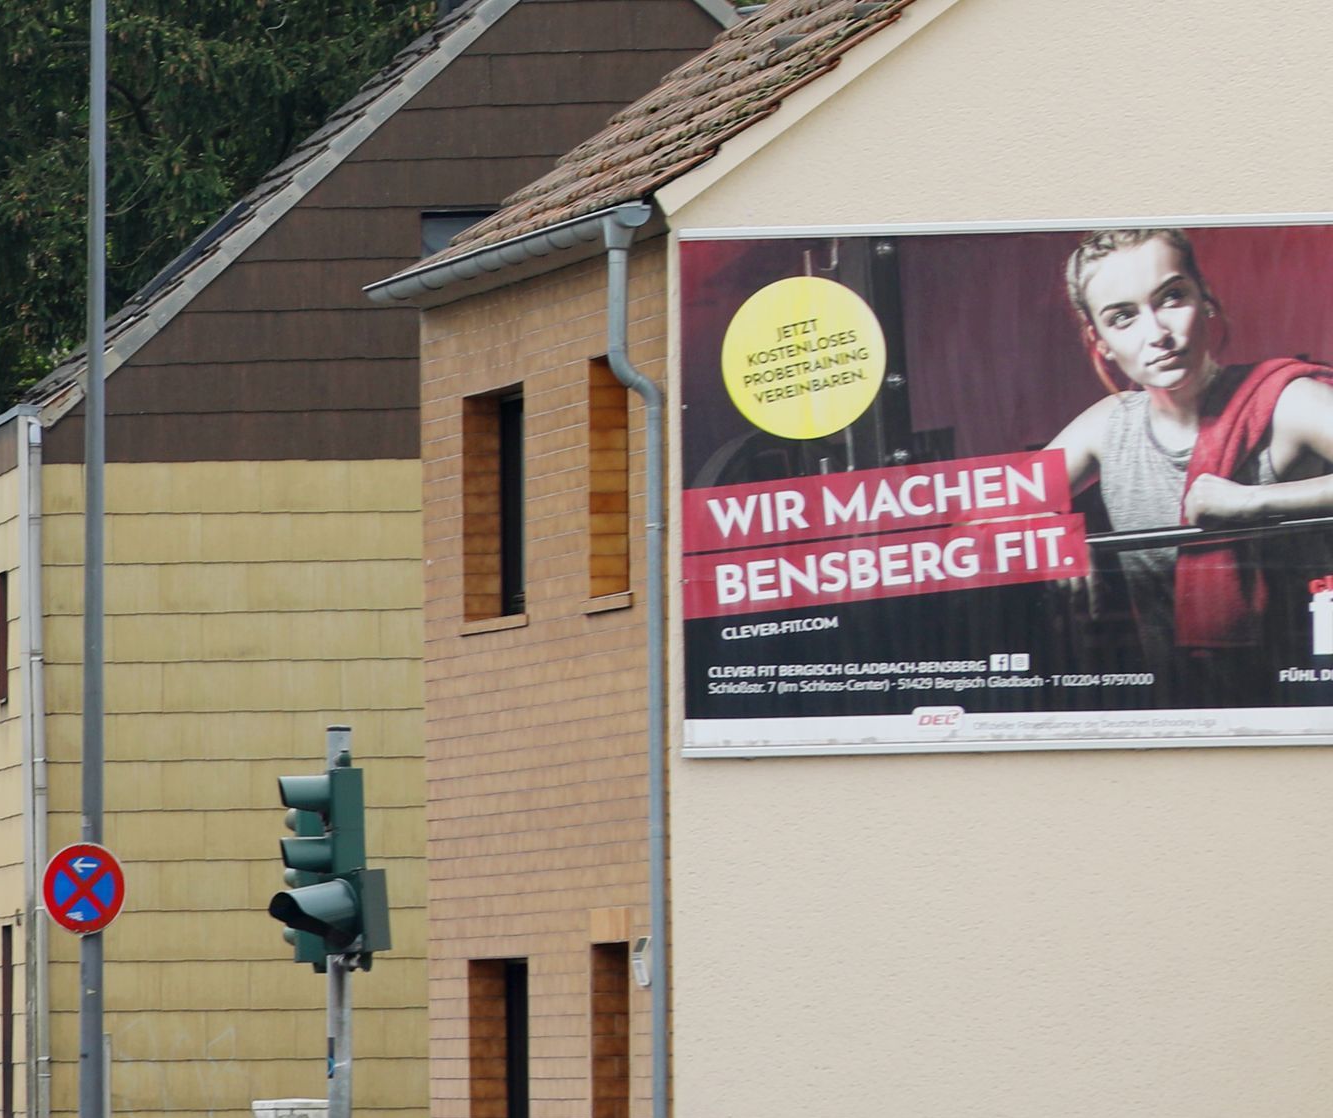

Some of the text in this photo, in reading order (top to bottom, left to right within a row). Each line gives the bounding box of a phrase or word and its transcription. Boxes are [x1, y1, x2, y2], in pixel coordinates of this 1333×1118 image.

[776, 318, 818, 342] JETZT
[746, 329, 857, 367] KOSTENLOSES
[742, 347, 870, 389] PROBETRAINING
[753, 368, 869, 405] VEREINBAREN.
[706, 462, 1047, 539] WIR MACHEN
[715, 526, 1075, 606] BENSBERG FIT.
[720, 615, 840, 641] CLEVER-FIT.COM
[707, 660, 987, 679] CLEVER FIT BERGISCH GLADBACH-BENSBERG
[767, 684, 774, 694] 7
[799, 678, 891, 694] Schloss-Center)
[897, 677, 933, 690] 51429
[935, 675, 985, 692] Bergisch
[987, 673, 1044, 688] Gladbach
[1052, 675, 1061, 686] T
[1062, 673, 1101, 687] 02204
[1101, 672, 1155, 687] 9797000
[1278, 667, 1319, 682] FÜHL
